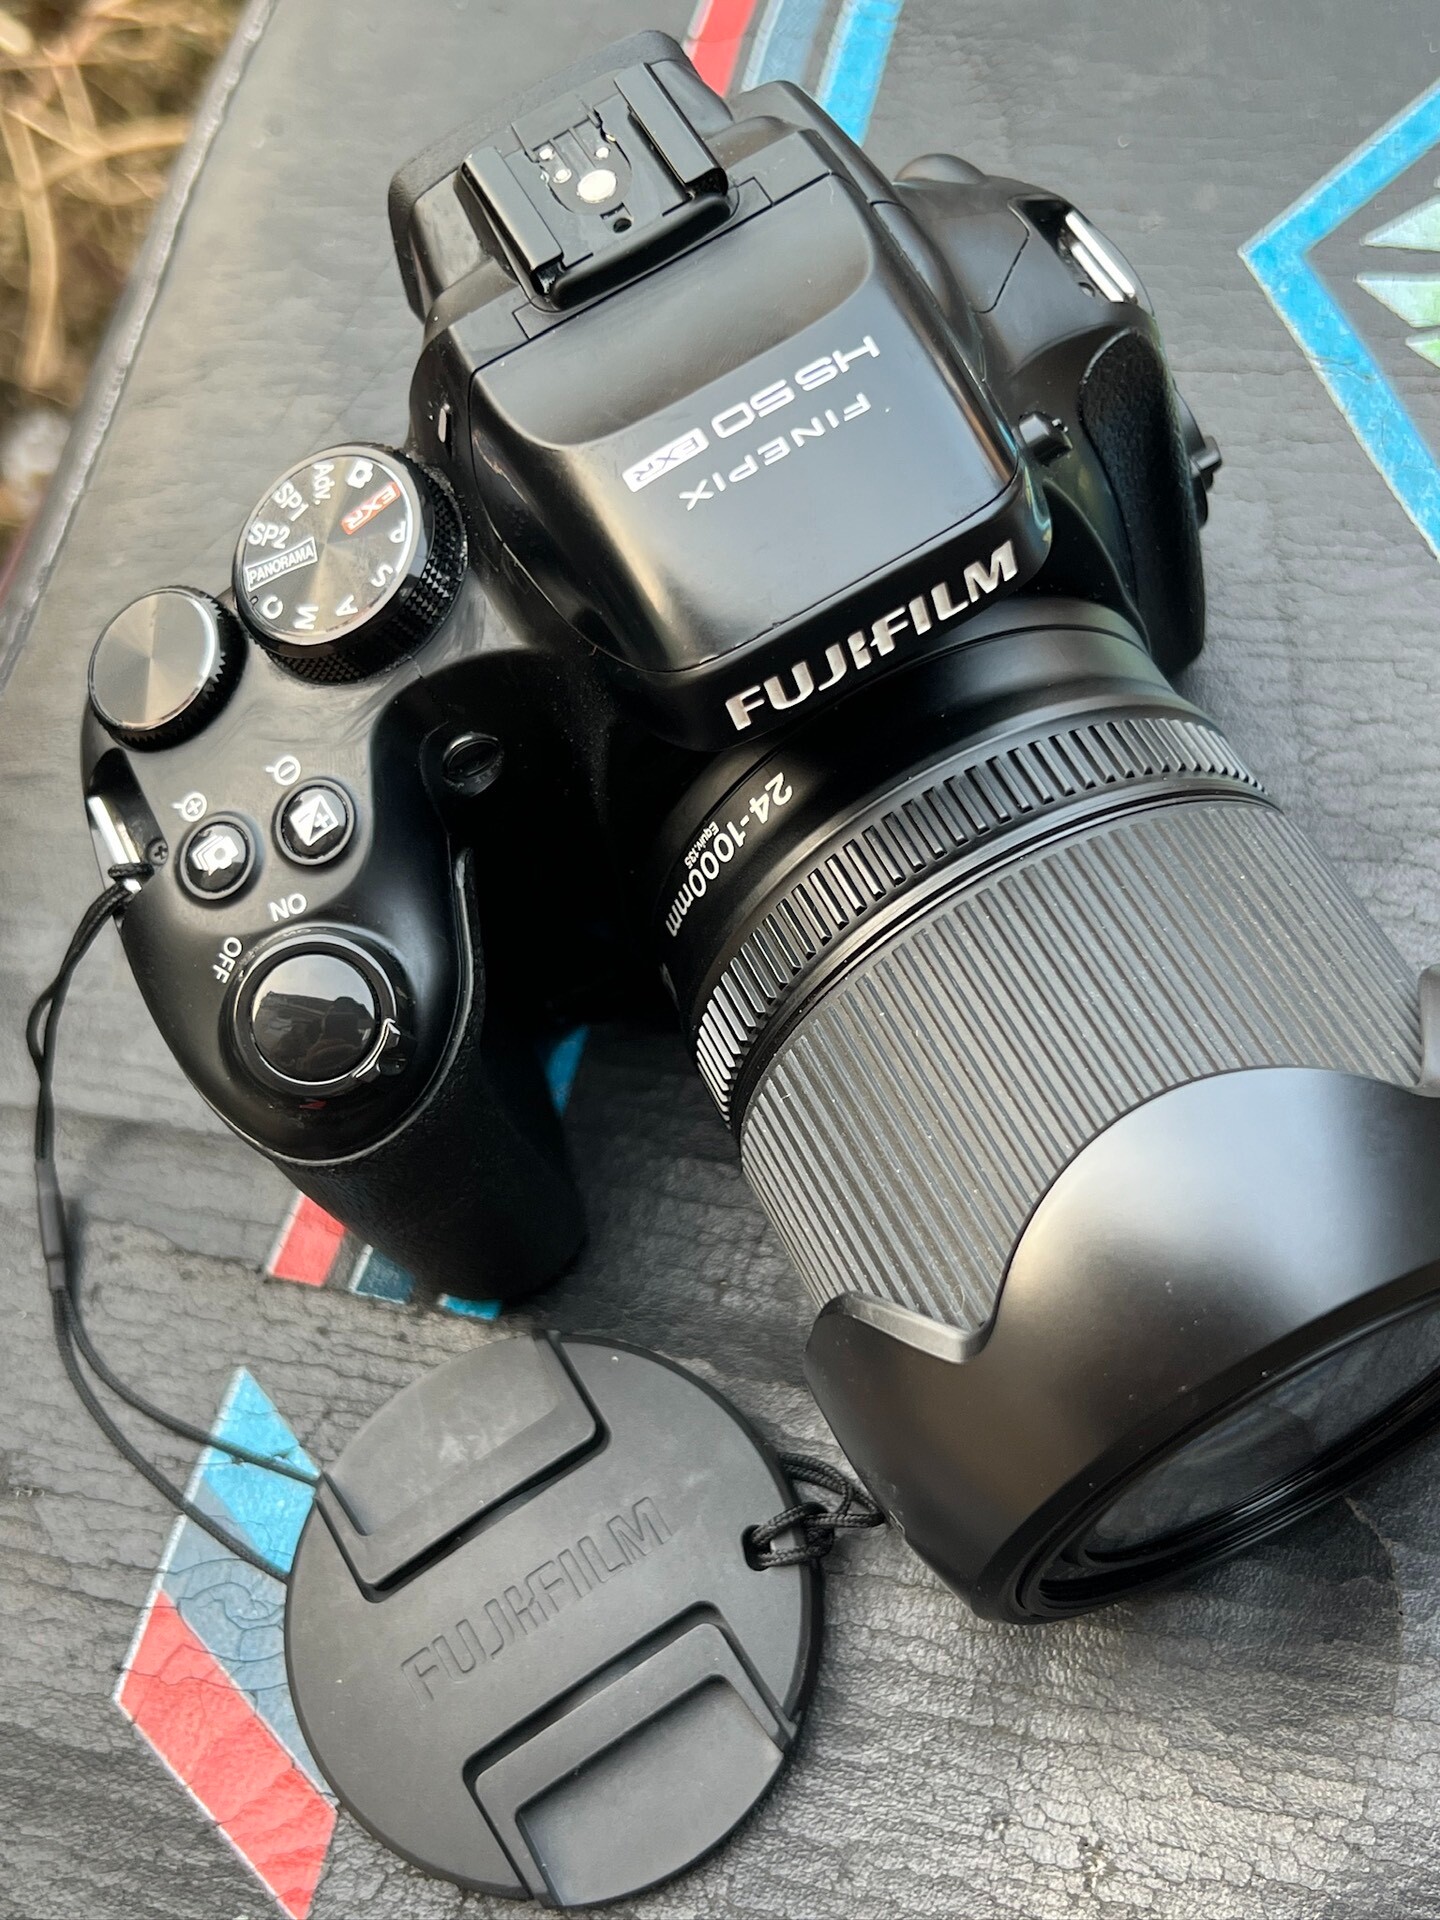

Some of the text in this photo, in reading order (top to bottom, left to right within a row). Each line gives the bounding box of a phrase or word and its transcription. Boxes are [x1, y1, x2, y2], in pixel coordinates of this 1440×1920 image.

[626, 429, 708, 489] EXR
[679, 392, 871, 511] FINEPIX
[272, 479, 310, 521] SP1
[312, 462, 335, 505] Adv.
[345, 484, 397, 530] EXR
[248, 522, 291, 549] SP2
[388, 520, 406, 544] P
[249, 544, 315, 584] PANORAMA
[370, 563, 394, 588] S
[261, 596, 284, 620] C
[293, 604, 319, 630] M
[335, 595, 359, 617] A
[725, 540, 1018, 731] FUJIFILM
[268, 893, 307, 922] ON
[212, 936, 242, 985] OFF
[400, 1496, 673, 1710] FUJIFILM
